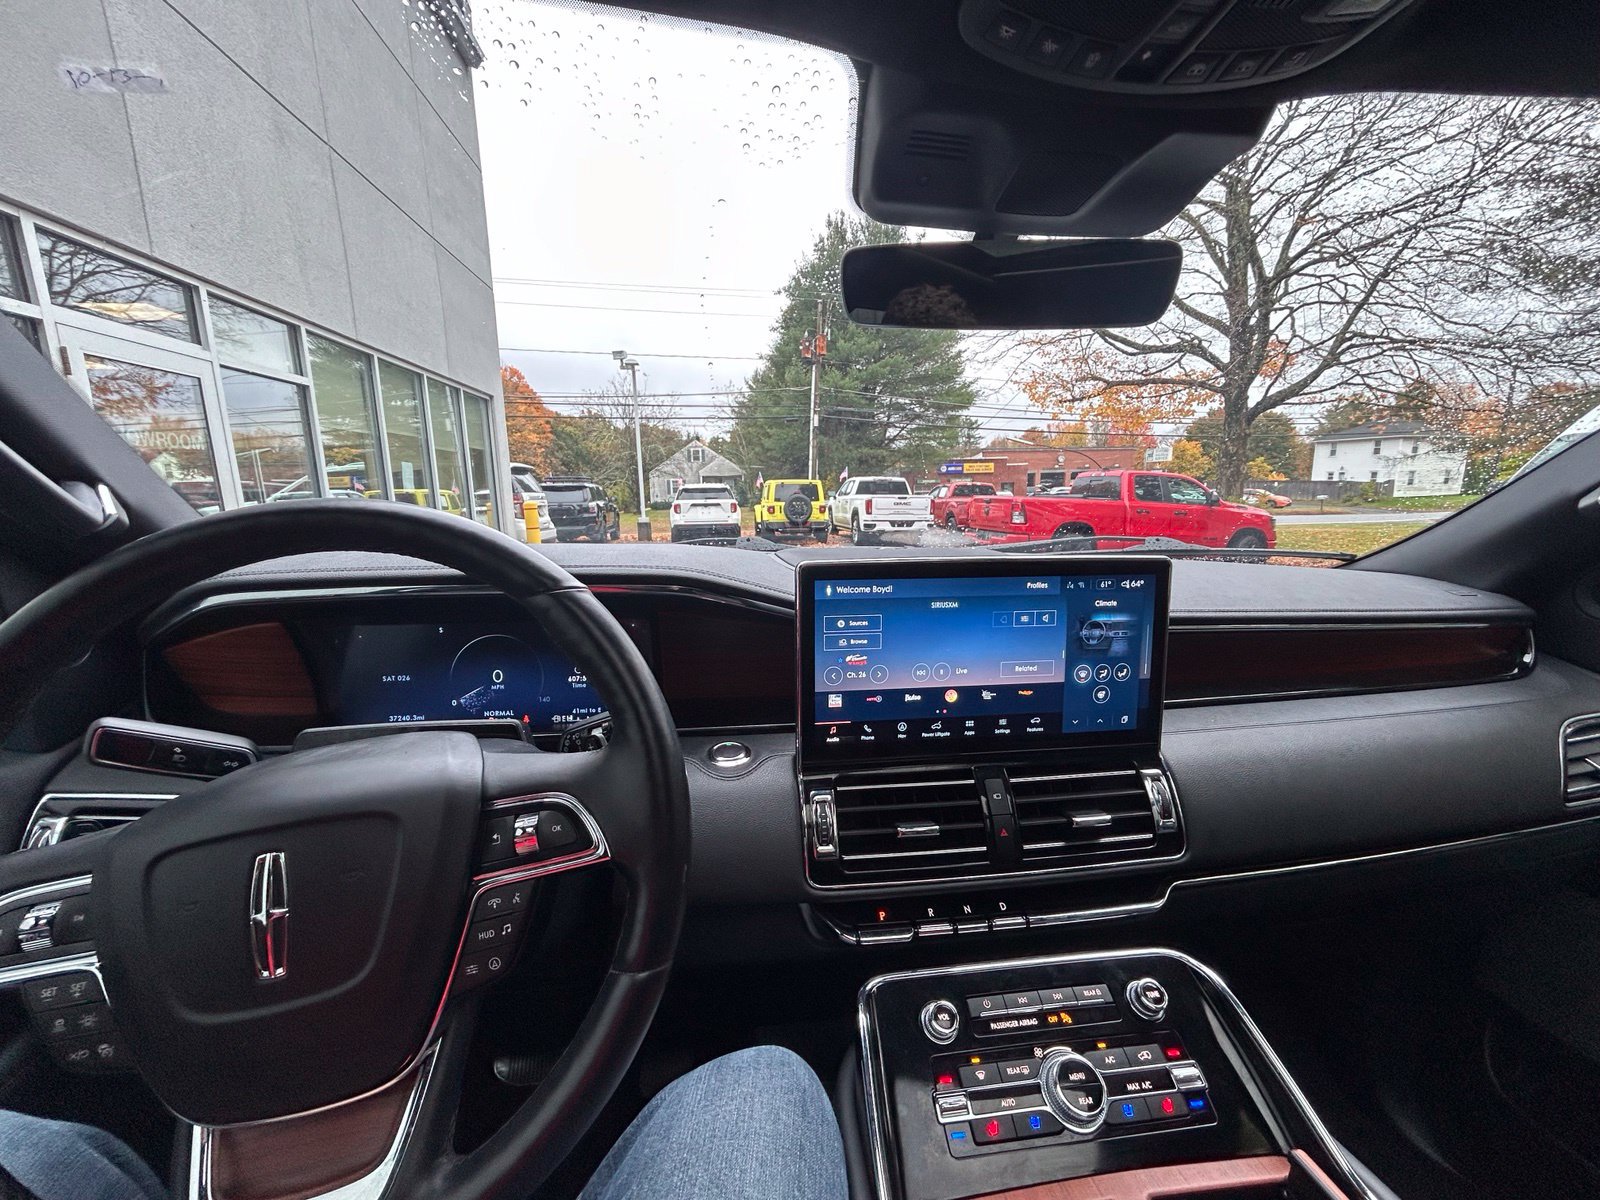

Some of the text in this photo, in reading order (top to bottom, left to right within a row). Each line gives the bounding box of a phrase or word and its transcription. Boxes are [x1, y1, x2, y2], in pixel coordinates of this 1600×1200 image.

[836, 585, 871, 594] Welcome
[1026, 581, 1049, 590] Profiles
[930, 601, 959, 609] SIRIUSXM
[955, 667, 968, 675] Live
[1015, 665, 1038, 673] Related
[846, 671, 858, 679] Ch.
[934, 730, 951, 738] Liftgate
[994, 727, 1011, 735] Settings
[551, 824, 563, 833] OK
[963, 905, 972, 914] N
[998, 902, 1007, 911] D
[879, 911, 886, 921] P
[927, 908, 935, 917] R
[478, 929, 495, 940] HUD
[69, 981, 87, 993] SET
[40, 986, 58, 998] SET
[1146, 990, 1161, 999] TUNE
[937, 1013, 951, 1021] VOL
[1047, 1015, 1058, 1023] OFF
[990, 1018, 1039, 1030] PASSENGER AIRBAG
[1105, 1056, 1116, 1064] A/C
[1006, 1066, 1021, 1075] REAR
[1068, 1072, 1086, 1081] MENU
[1126, 1080, 1153, 1091] MAX A/C
[1001, 1098, 1016, 1107] AUTO
[1078, 1096, 1094, 1105] REAR
